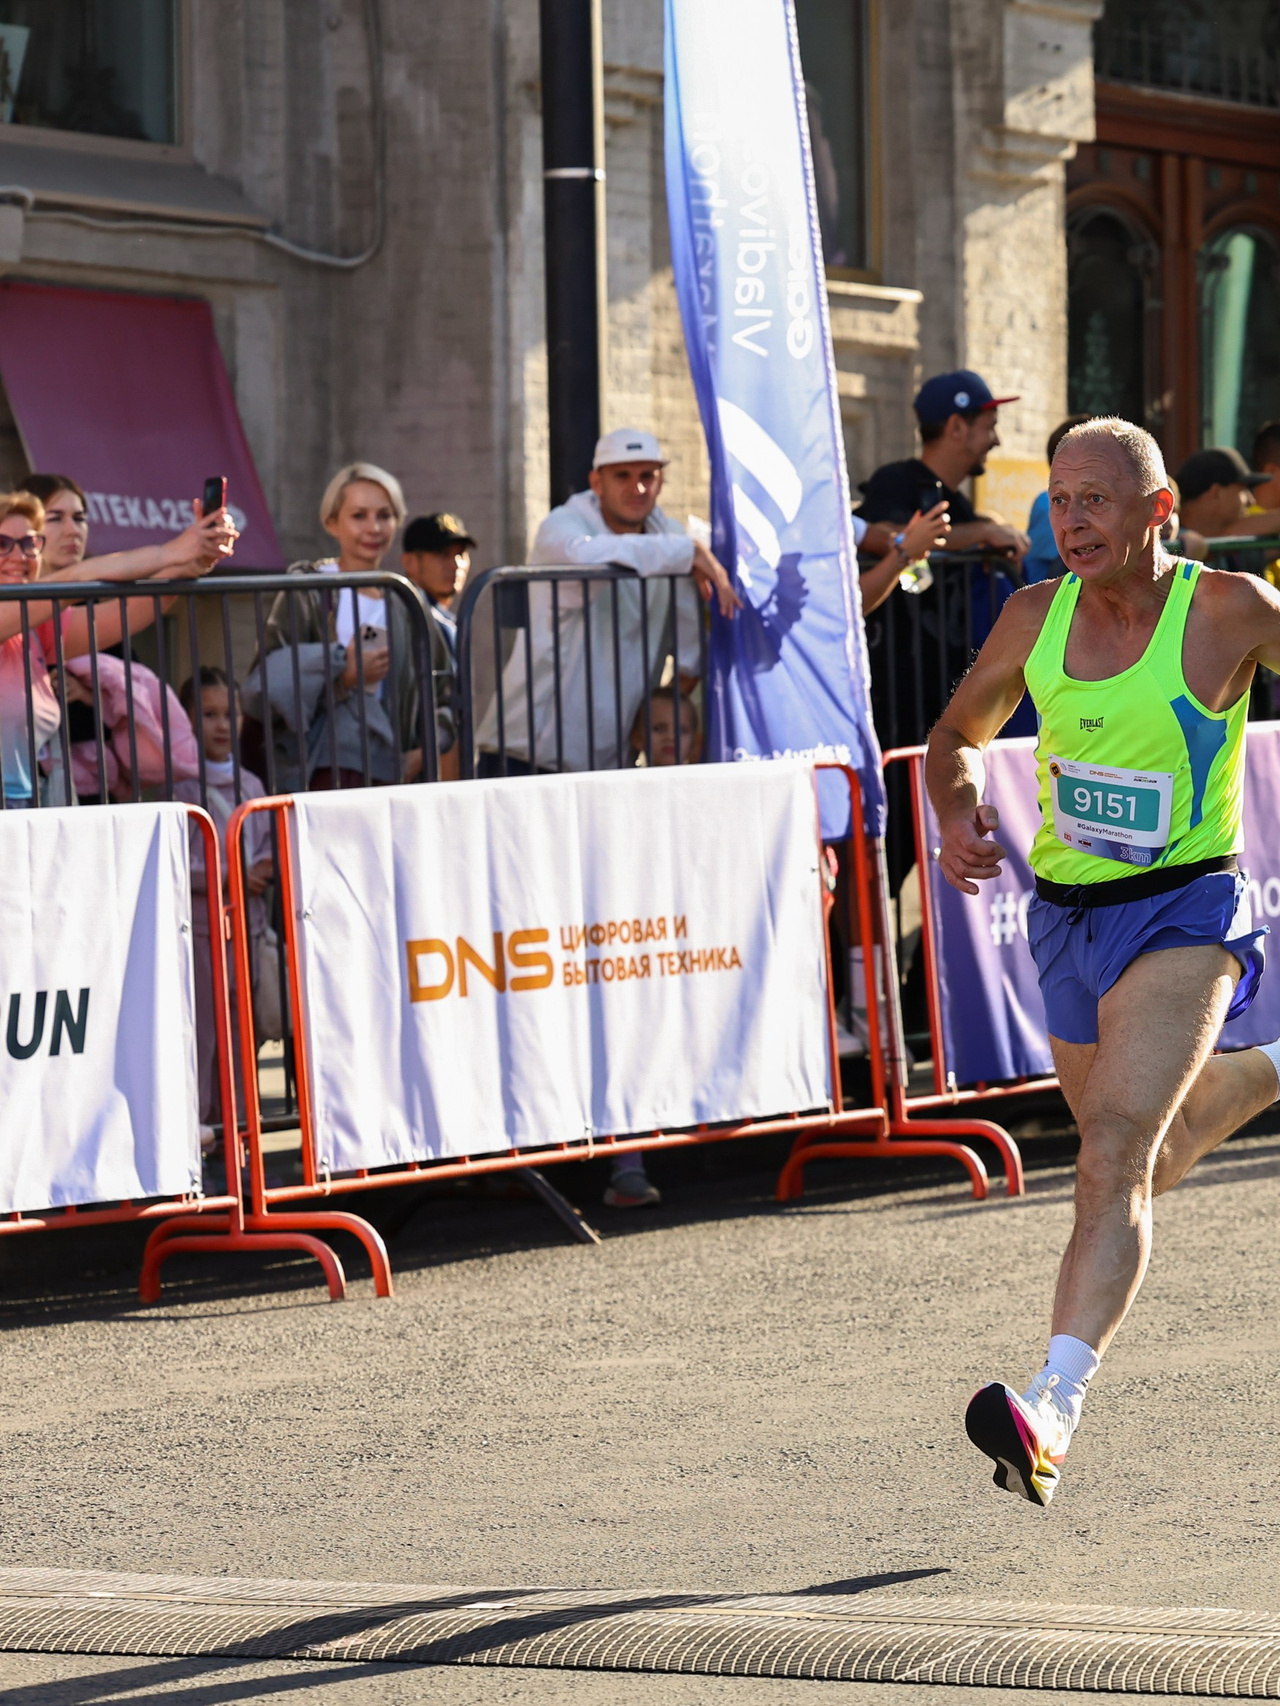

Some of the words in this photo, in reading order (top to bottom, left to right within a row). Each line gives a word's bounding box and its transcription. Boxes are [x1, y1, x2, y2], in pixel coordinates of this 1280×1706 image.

[1080, 716, 1104, 729] EVERLAST
[1073, 787, 1136, 822] 9151
[1077, 822, 1133, 840] #GalaxyMarathon
[1120, 846, 1152, 864] 3km
[560, 916, 667, 953] ЦИФРОВАЯ
[673, 914, 689, 940] И
[405, 928, 554, 1004] DNS
[562, 957, 650, 988] БЫТОВАЯ
[657, 946, 744, 977] ТЕХНИКА
[1, 987, 90, 1060] UN
